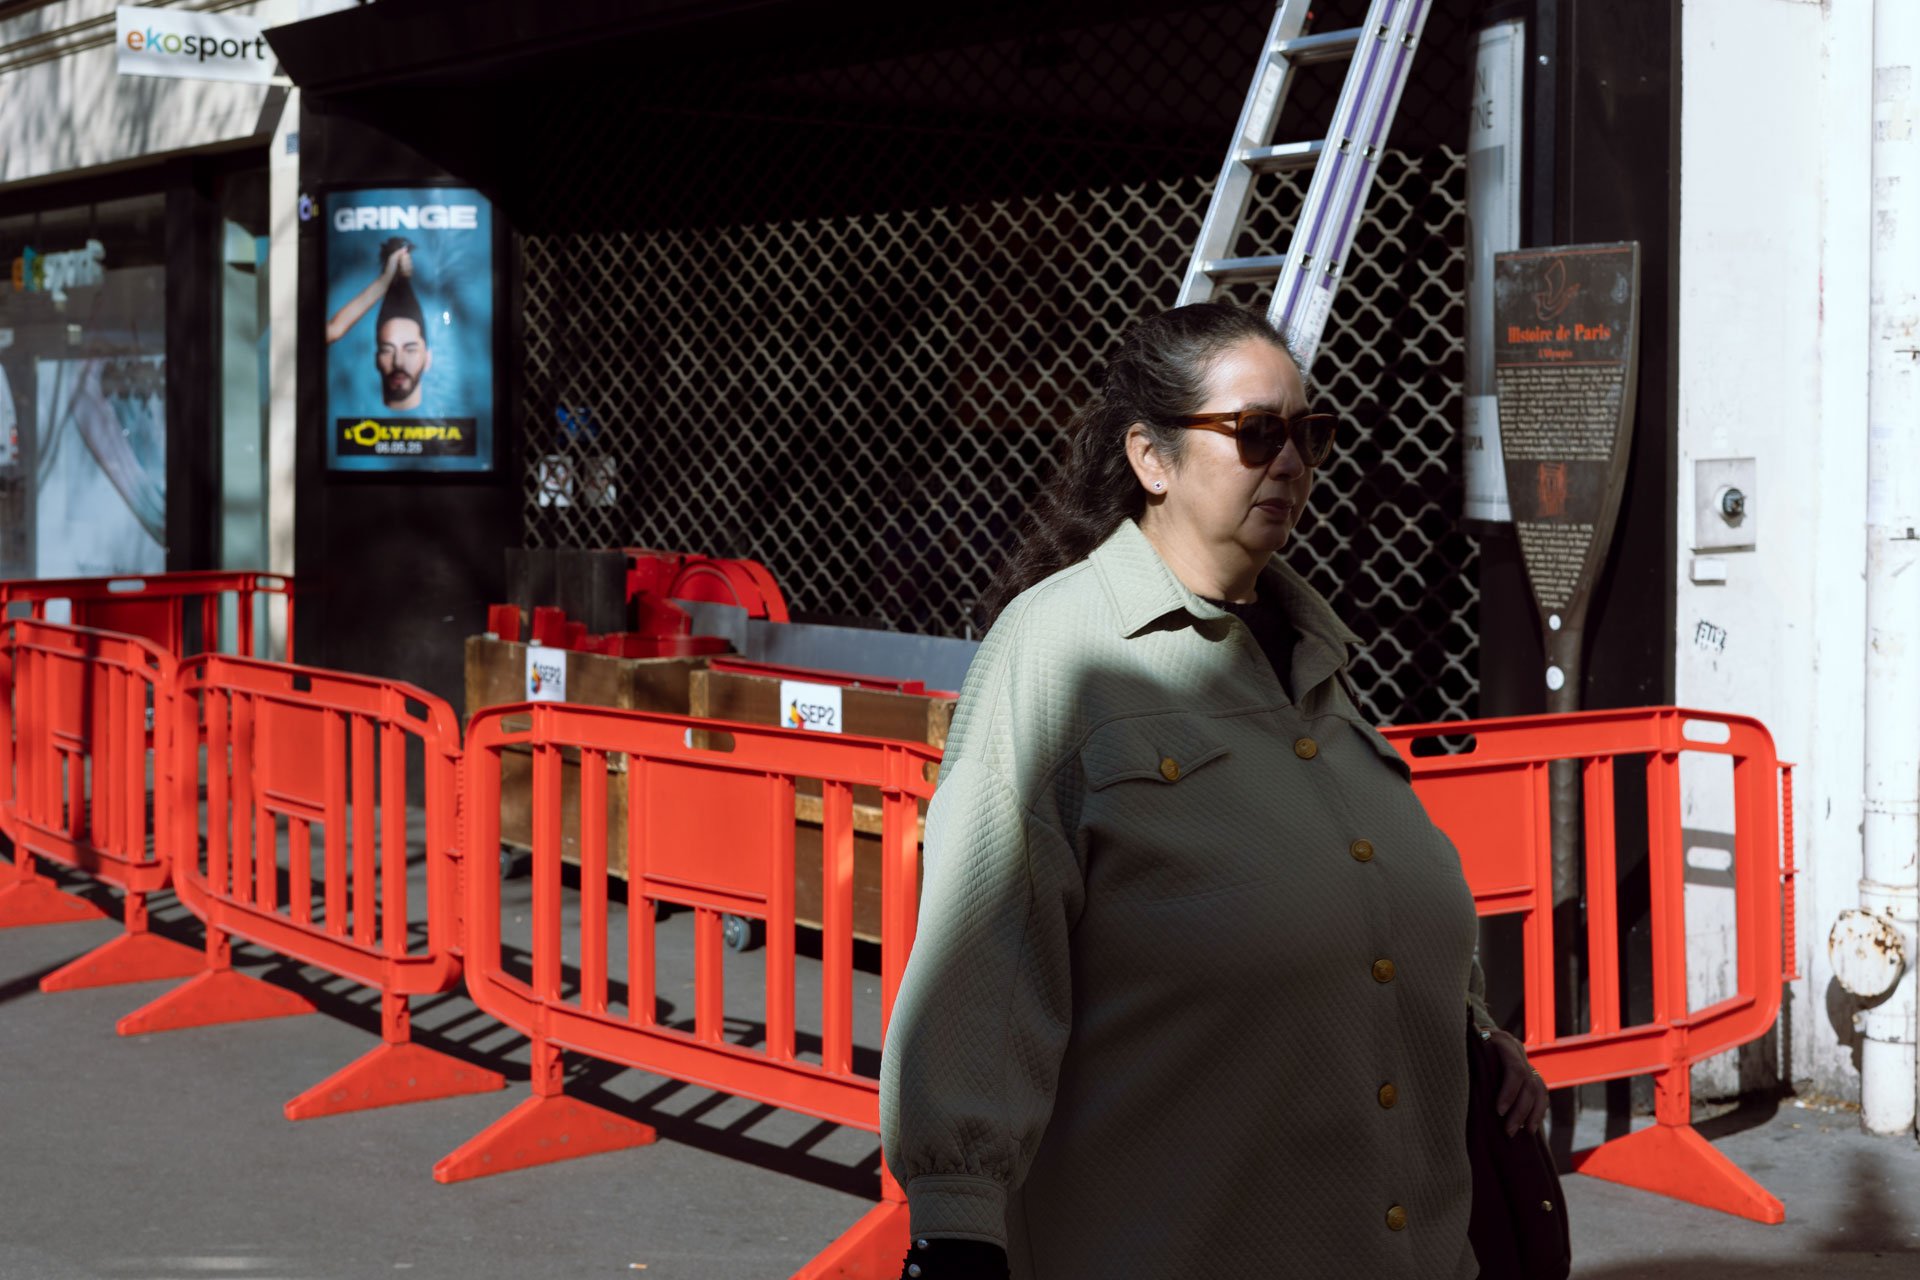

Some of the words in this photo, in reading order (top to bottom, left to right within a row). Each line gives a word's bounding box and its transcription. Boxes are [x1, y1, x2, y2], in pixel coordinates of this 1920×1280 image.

[125, 26, 267, 63] ekosport
[333, 205, 479, 232] GRINGE
[1508, 326, 1552, 343] Histoire
[1556, 323, 1571, 341] de
[1575, 323, 1611, 341] Paris
[538, 664, 561, 685] SEP2
[799, 703, 835, 727] SEP2
